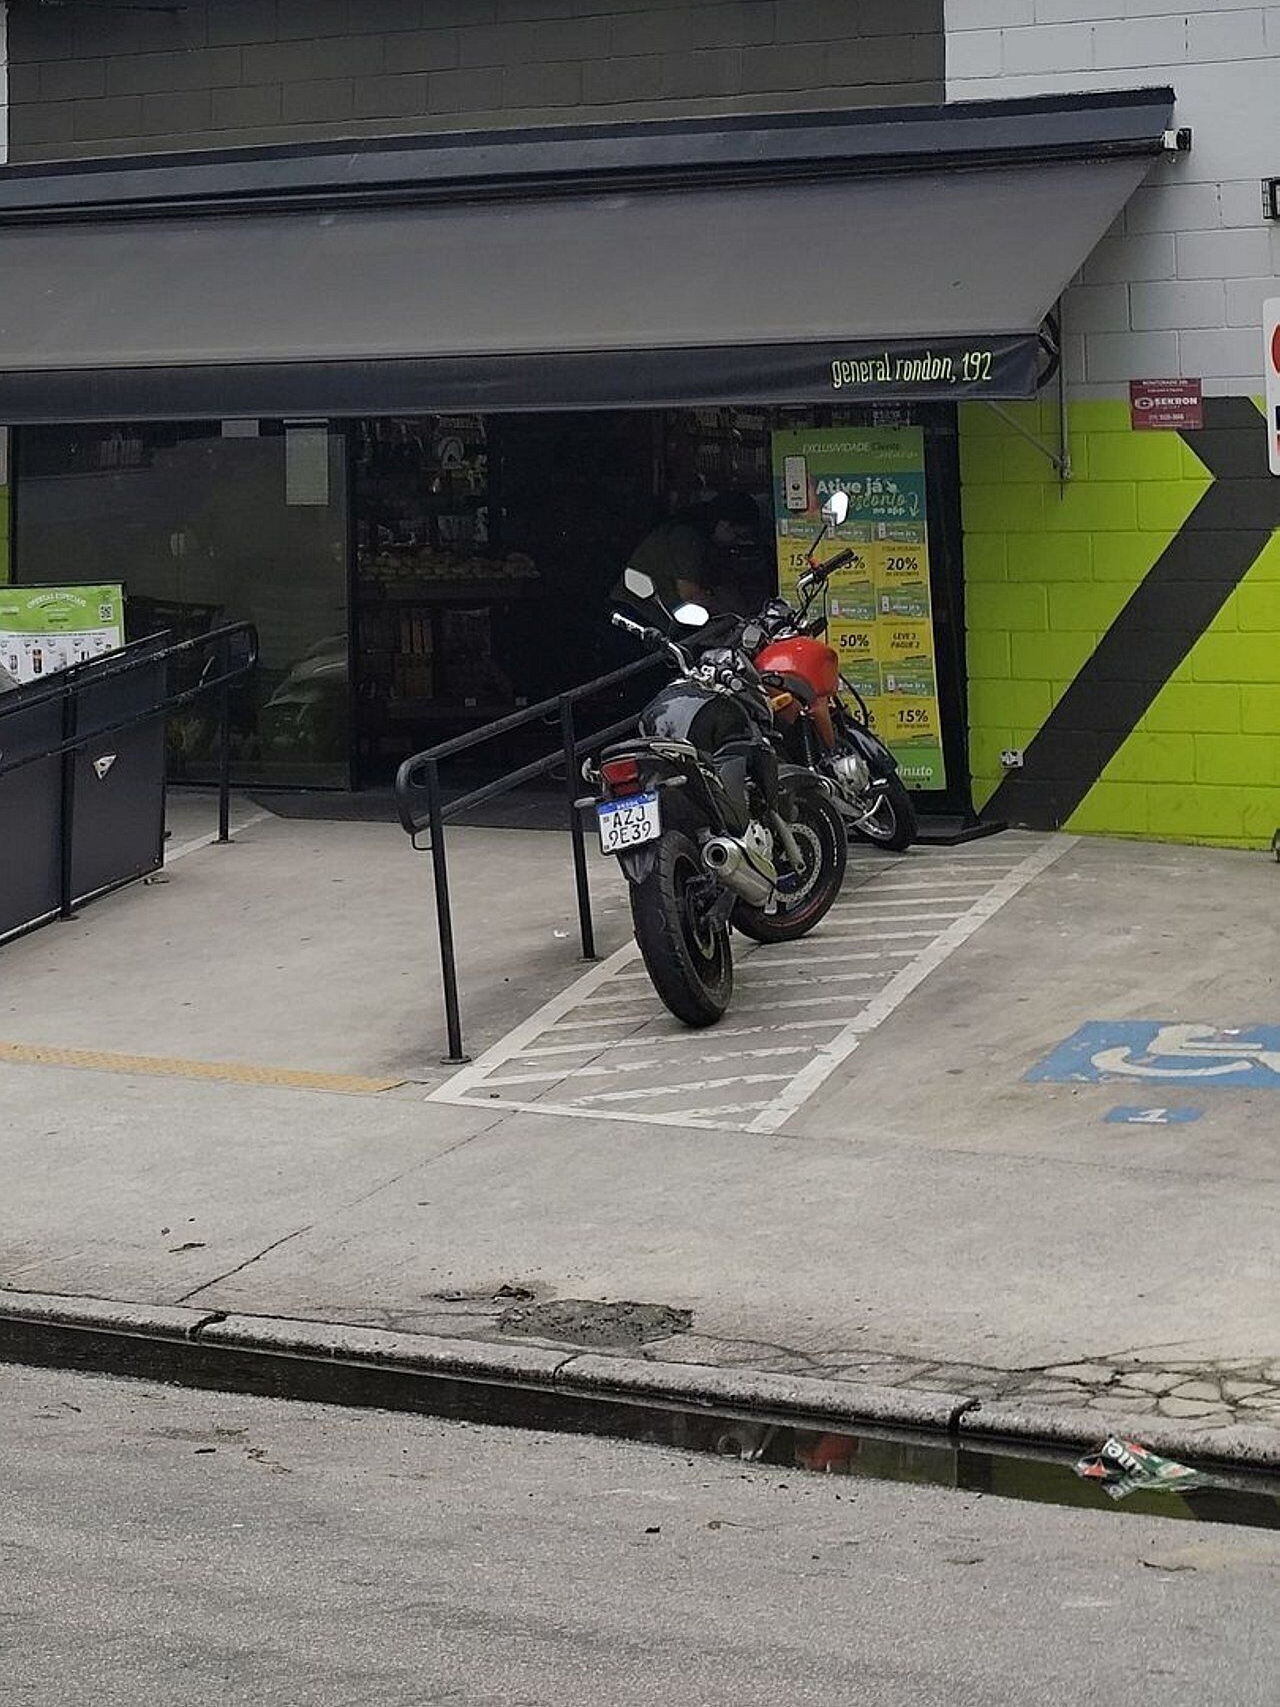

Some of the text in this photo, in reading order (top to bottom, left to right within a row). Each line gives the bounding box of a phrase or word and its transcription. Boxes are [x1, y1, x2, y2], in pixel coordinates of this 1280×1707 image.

[831, 351, 993, 388] general rondon, 192
[816, 477, 883, 498] Ative já
[840, 633, 869, 647] 50%
[613, 805, 646, 829] AZJ
[608, 820, 652, 847] 9E39
